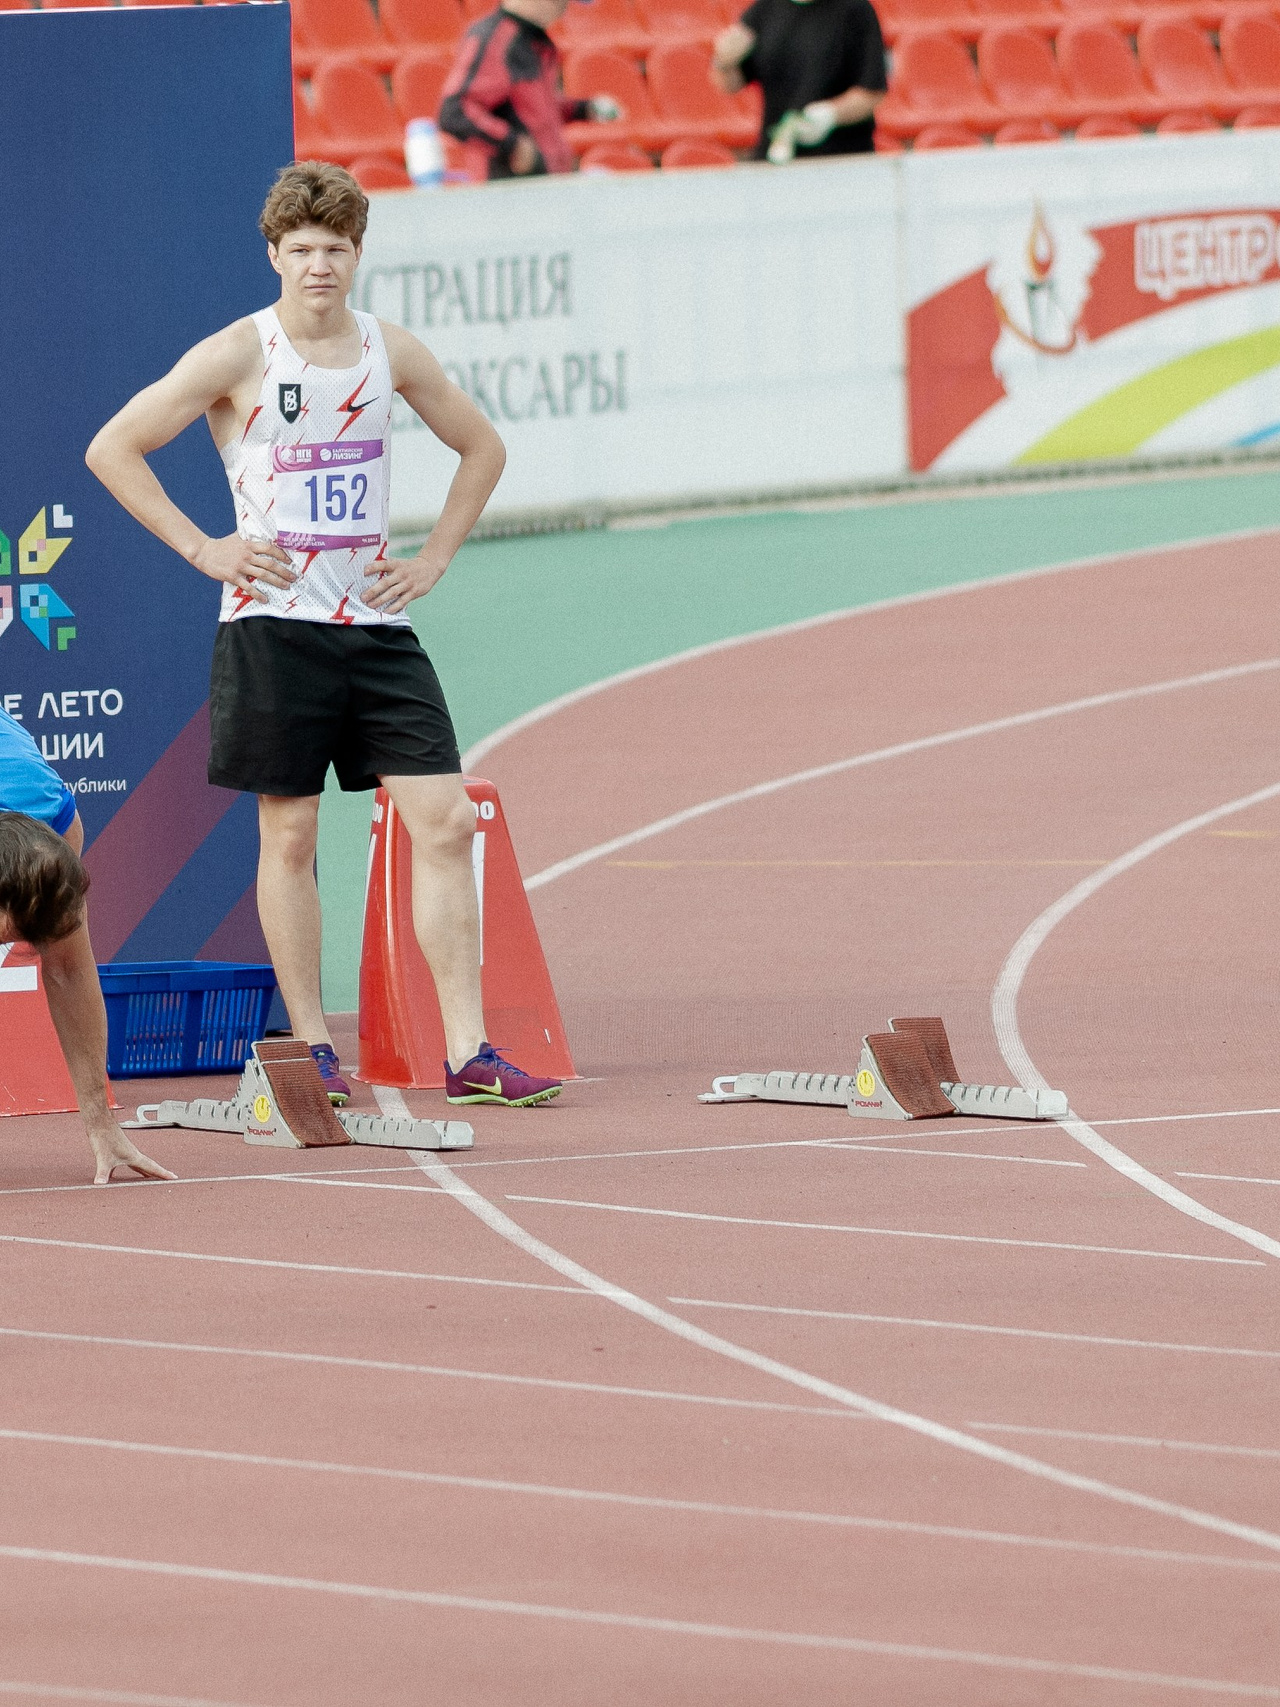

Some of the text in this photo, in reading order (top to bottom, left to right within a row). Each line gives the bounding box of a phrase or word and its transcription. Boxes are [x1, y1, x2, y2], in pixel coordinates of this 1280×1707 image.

[1134, 214, 1273, 301] ЦЕНТР
[305, 473, 368, 522] 152
[38, 688, 124, 719] ЛЕТО
